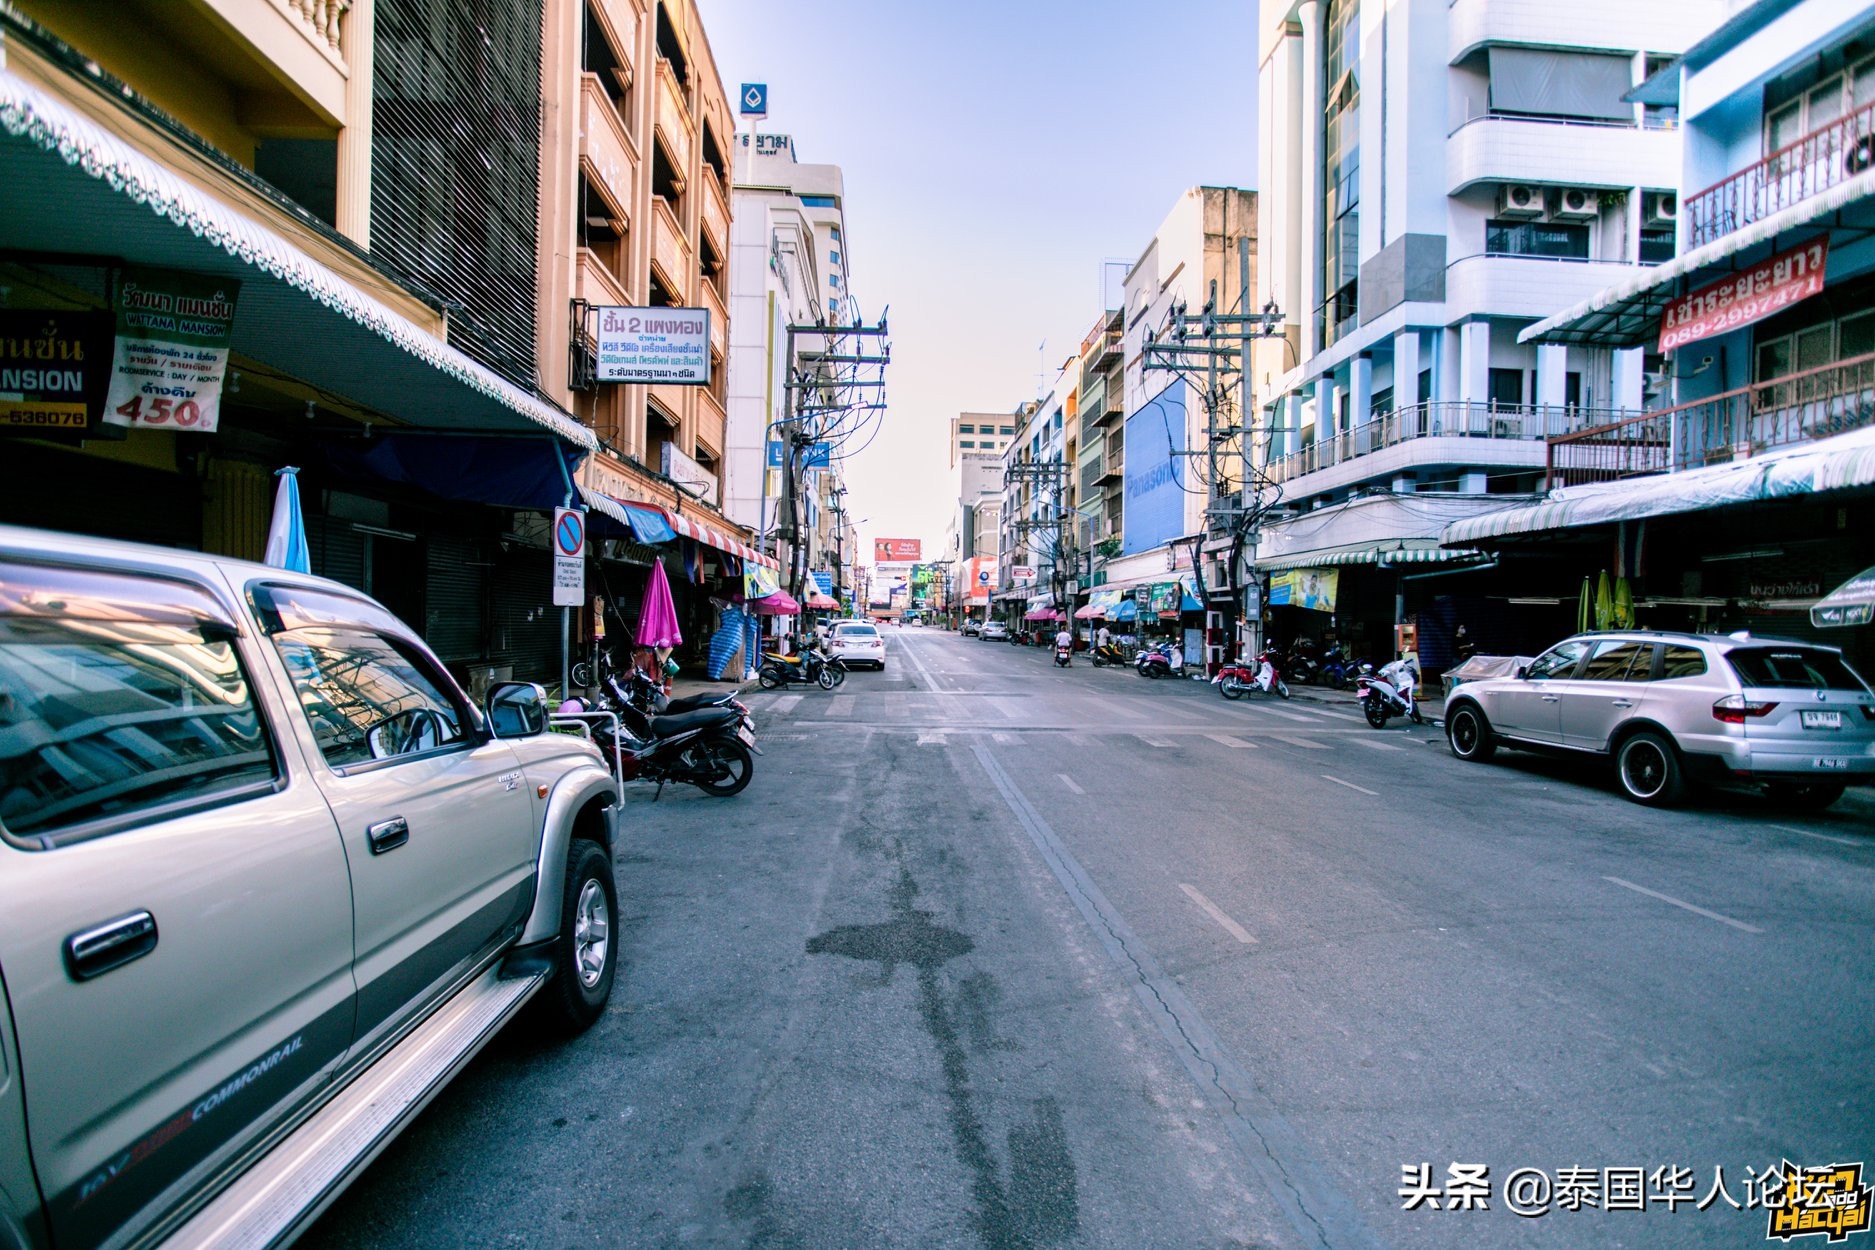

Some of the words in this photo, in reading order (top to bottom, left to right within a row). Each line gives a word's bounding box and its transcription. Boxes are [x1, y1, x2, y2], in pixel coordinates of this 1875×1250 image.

[1666, 244, 1823, 329] เช่าระยะยาว
[176, 291, 233, 320] แมนชั่น
[1663, 276, 1817, 348] 089-2997471
[126, 313, 176, 331] WATTANA
[179, 320, 226, 336] MANSION
[603, 310, 625, 333] ชั้น
[628, 317, 641, 333] 2
[645, 319, 703, 335] แผงทอง
[183, 351, 195, 360] 24
[0, 368, 83, 392] NSION
[171, 371, 187, 381] DAY
[197, 375, 220, 383] MONTH
[116, 395, 200, 427] 450
[192, 1036, 303, 1121] COMMONRAIL
